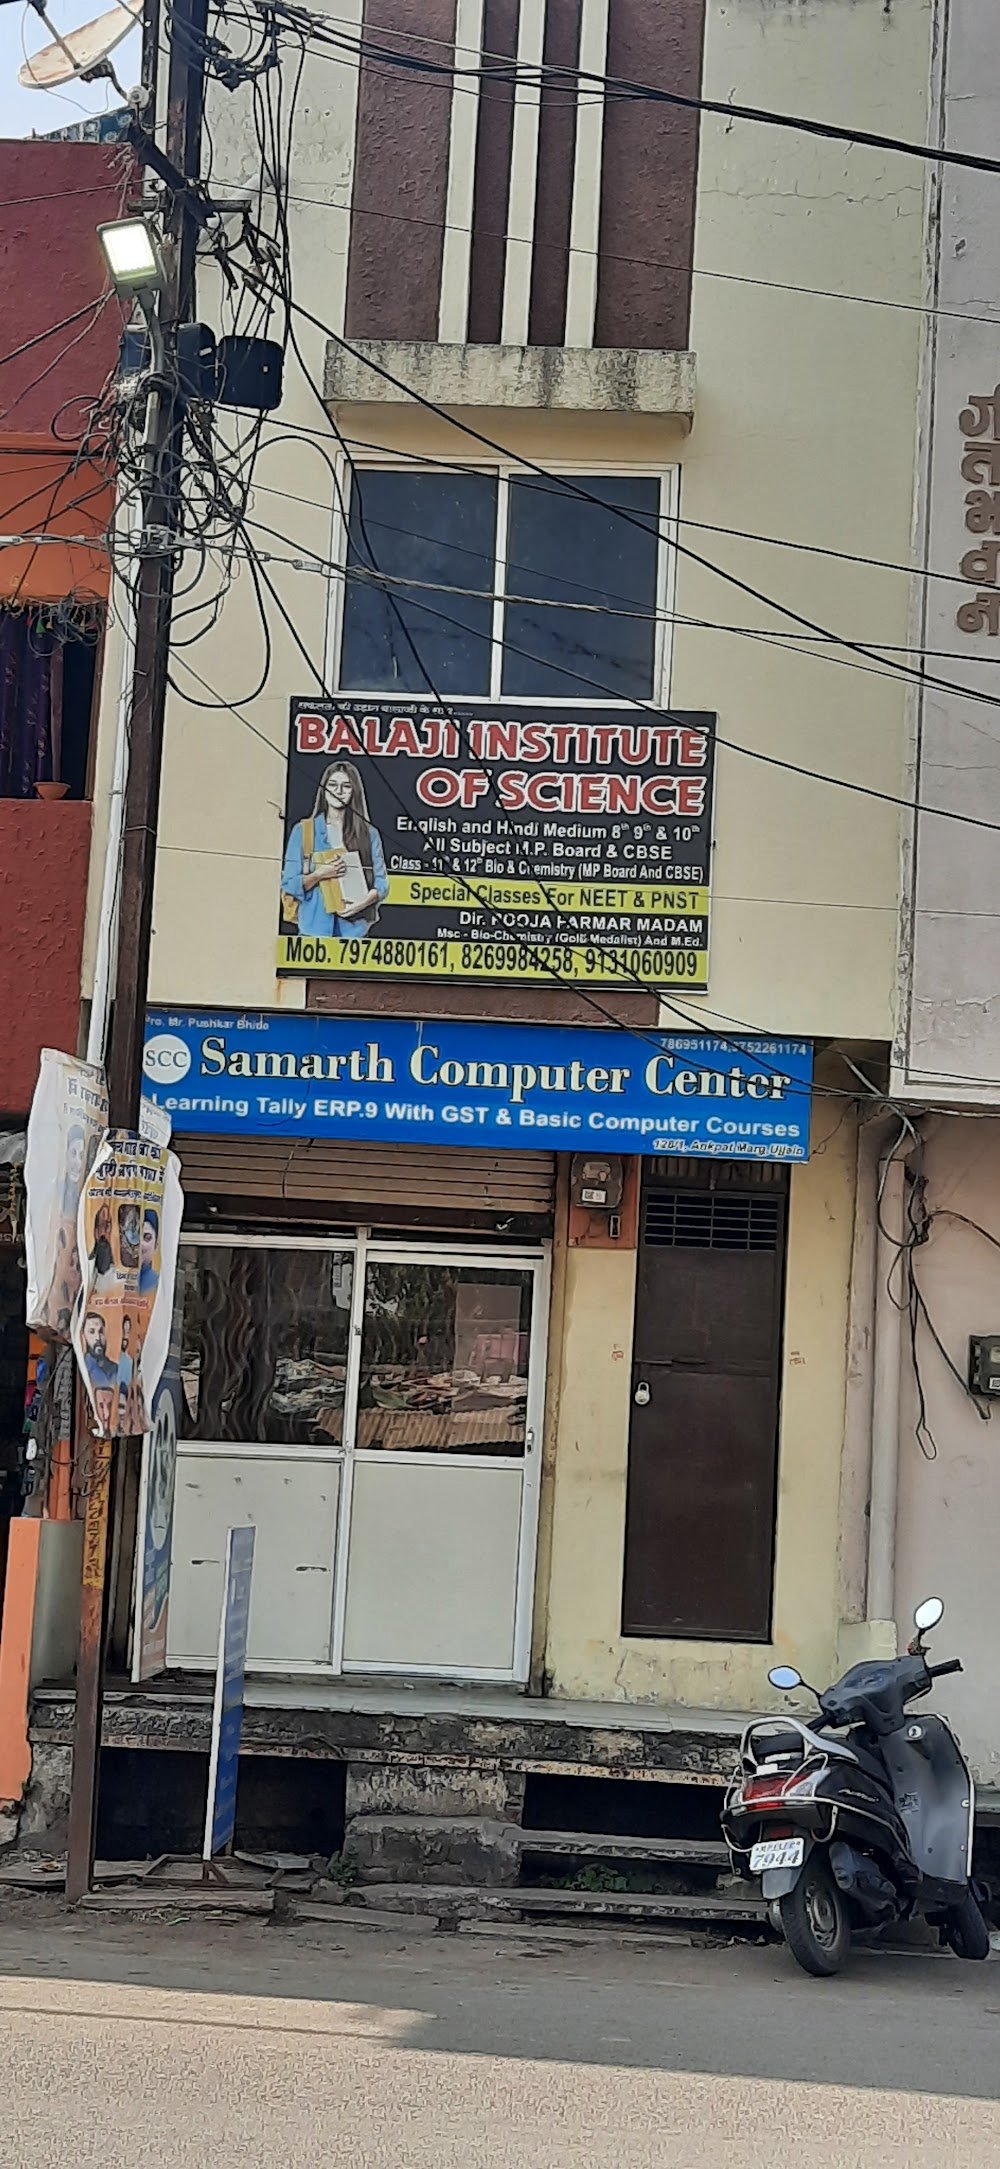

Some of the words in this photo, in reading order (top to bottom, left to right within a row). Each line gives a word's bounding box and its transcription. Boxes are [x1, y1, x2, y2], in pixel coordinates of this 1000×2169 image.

[295, 714, 461, 758] BALAJI
[467, 719, 709, 767] INSTITUTE
[416, 767, 491, 809] OF
[495, 769, 707, 816] SCIENCE
[397, 816, 457, 835] English
[461, 819, 491, 834] and
[497, 820, 539, 836] Hindi
[543, 822, 607, 839] Medium
[655, 825, 668, 841] &
[423, 836, 446, 853] All
[450, 838, 511, 856] Subject
[552, 842, 602, 858] Board
[606, 843, 618, 859] &
[623, 844, 673, 860] CBSE
[390, 855, 422, 870] Class
[452, 857, 461, 872] &
[485, 859, 504, 874] Bio
[507, 860, 516, 874] &
[578, 862, 601, 880] (MP
[603, 864, 637, 879] Board
[639, 865, 662, 879] And
[665, 865, 704, 884] CBSE)
[410, 882, 470, 903] Special
[476, 884, 541, 904] Classes
[547, 887, 575, 905] For
[579, 888, 628, 907] NEET
[633, 891, 645, 908] &
[651, 891, 699, 910] PNST
[459, 911, 486, 926] Dir.
[491, 912, 552, 929] POOJA
[636, 918, 703, 934] MADAM
[437, 927, 460, 938] Msc
[644, 935, 668, 946] And
[671, 936, 703, 948] M.Ed.
[286, 937, 331, 963] Mob.
[339, 938, 455, 972] 7974880161,
[145, 1050, 188, 1067] SCC
[200, 1036, 396, 1083] Samarth
[409, 1045, 630, 1103] Computer
[645, 1055, 791, 1100] Center
[152, 1093, 249, 1118] Learning
[256, 1097, 307, 1119] Tally
[314, 1099, 378, 1119] ERP.9
[385, 1101, 434, 1122] With
[441, 1105, 489, 1124] GST
[496, 1109, 512, 1126] &
[519, 1109, 582, 1128] Basic
[588, 1111, 700, 1135] Computer
[705, 1116, 800, 1137] Courses
[691, 1140, 733, 1153] Ankpat
[753, 1850, 799, 1868] 7944
